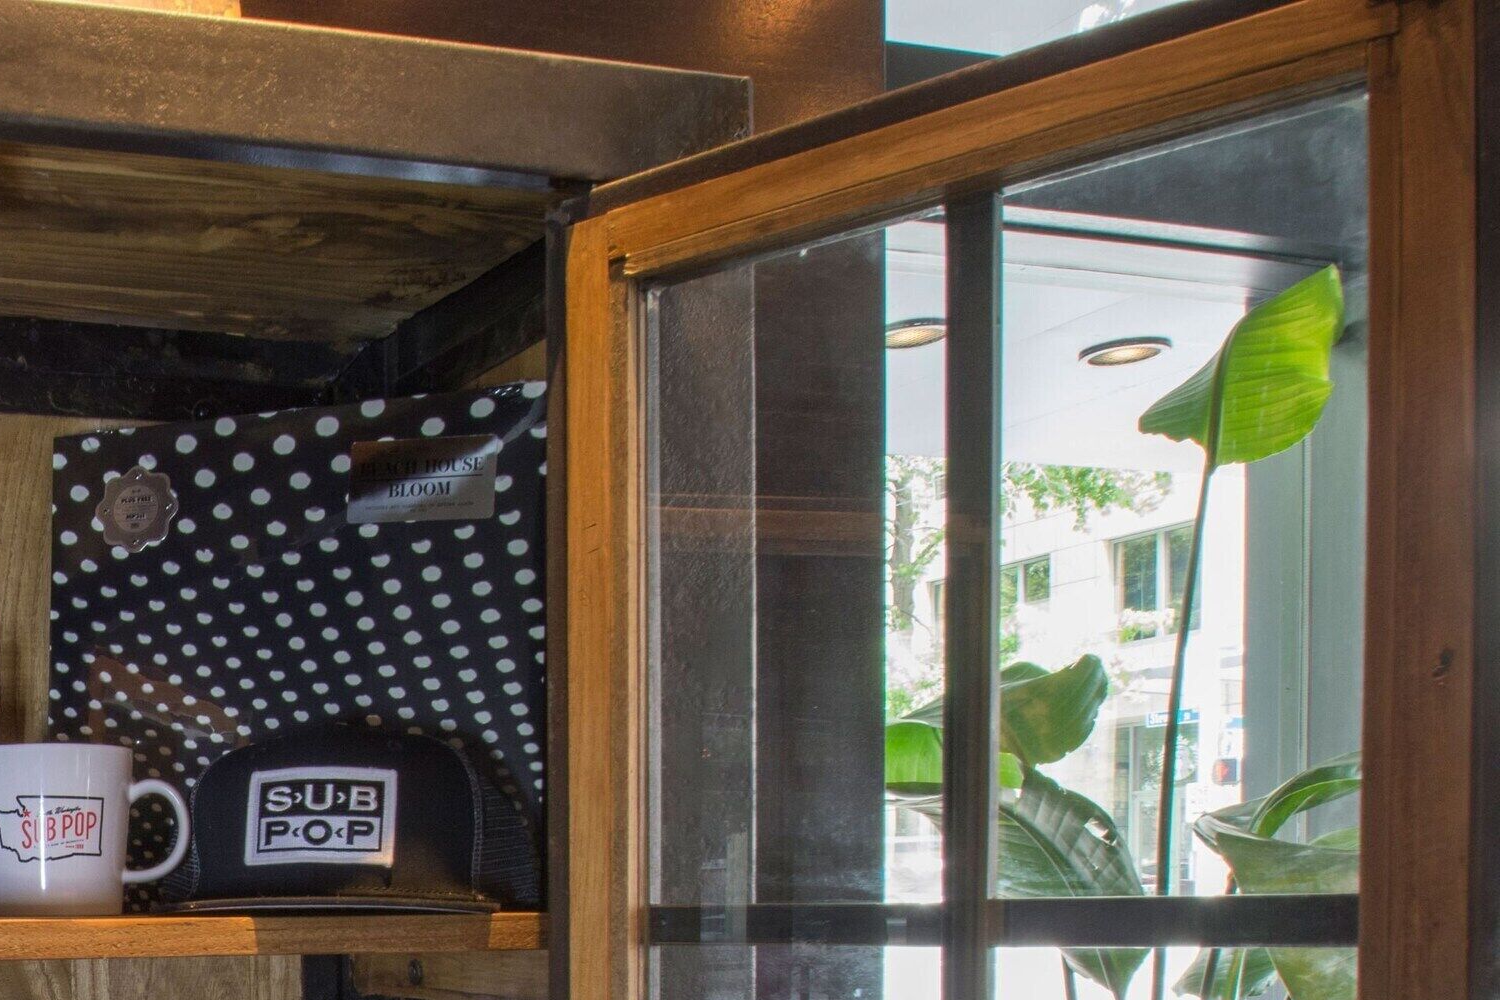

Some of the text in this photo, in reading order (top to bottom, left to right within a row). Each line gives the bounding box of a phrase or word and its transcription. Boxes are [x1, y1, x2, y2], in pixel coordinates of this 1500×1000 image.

[425, 456, 485, 473] HOUSE
[388, 481, 451, 498] BLOOM
[265, 783, 378, 811] SUB
[62, 811, 97, 840] POP
[264, 819, 375, 847] POP
